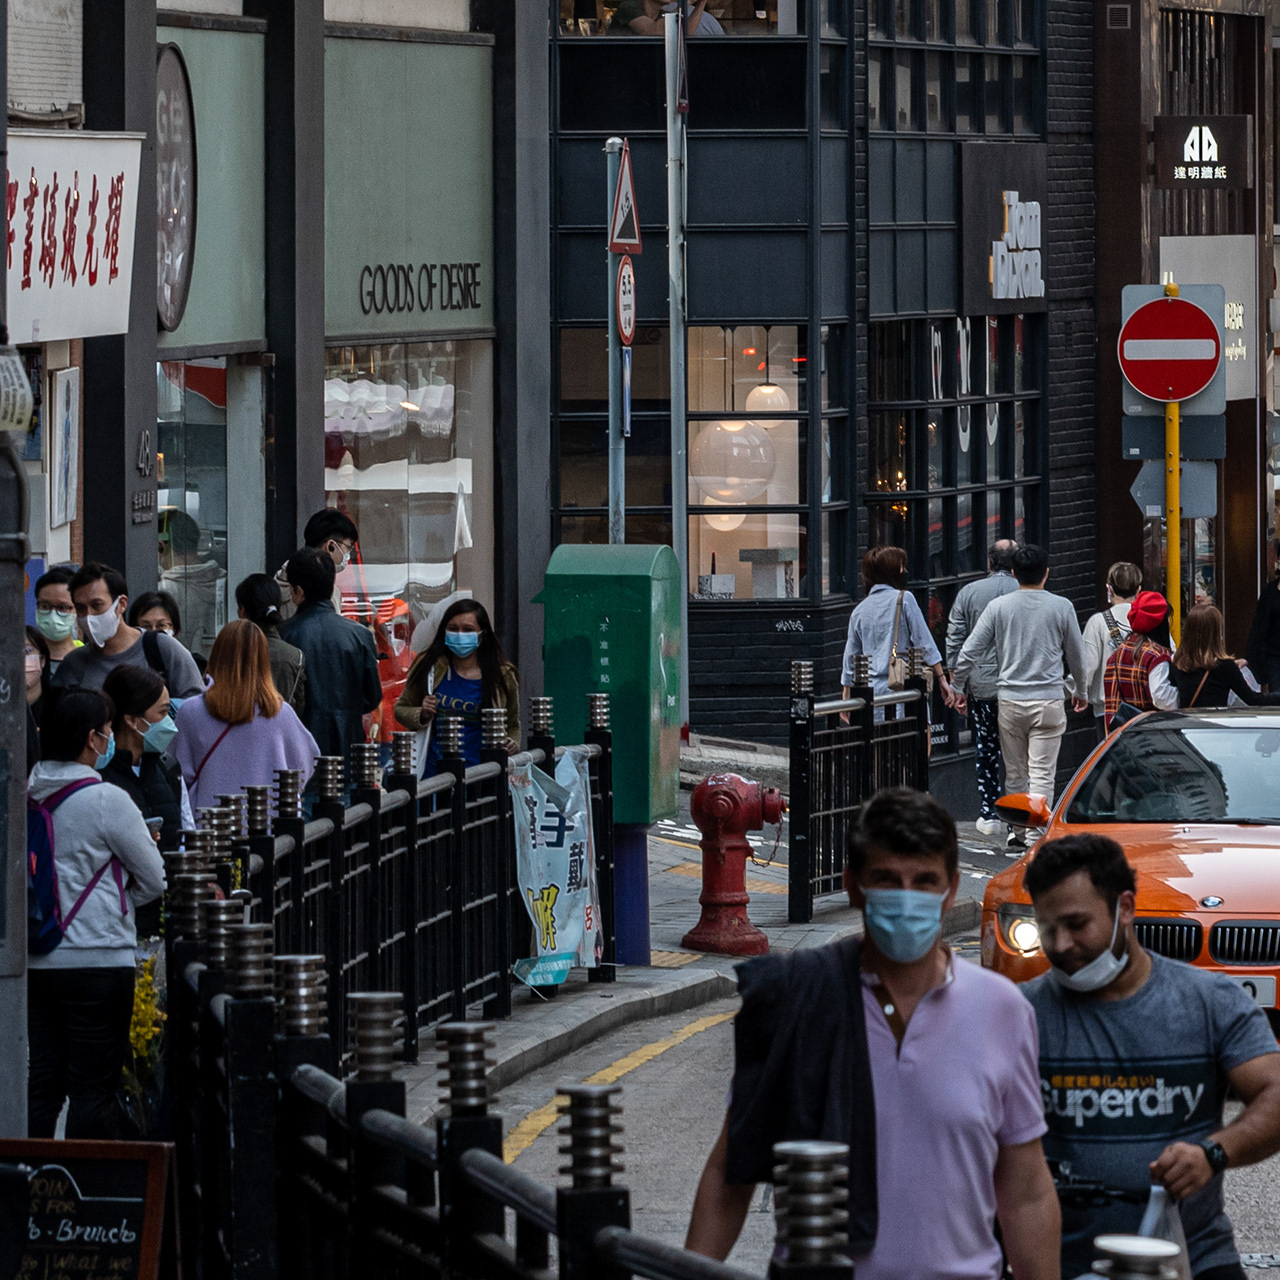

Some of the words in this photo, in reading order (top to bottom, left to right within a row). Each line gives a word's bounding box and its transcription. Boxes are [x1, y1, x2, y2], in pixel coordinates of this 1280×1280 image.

[359, 264, 414, 315] GOODS
[418, 263, 437, 312] OF
[440, 263, 481, 311] DESIRE
[137, 429, 152, 477] 48
[1041, 1078, 1205, 1128] Superdry
[56, 1218, 137, 1244] Brunch
